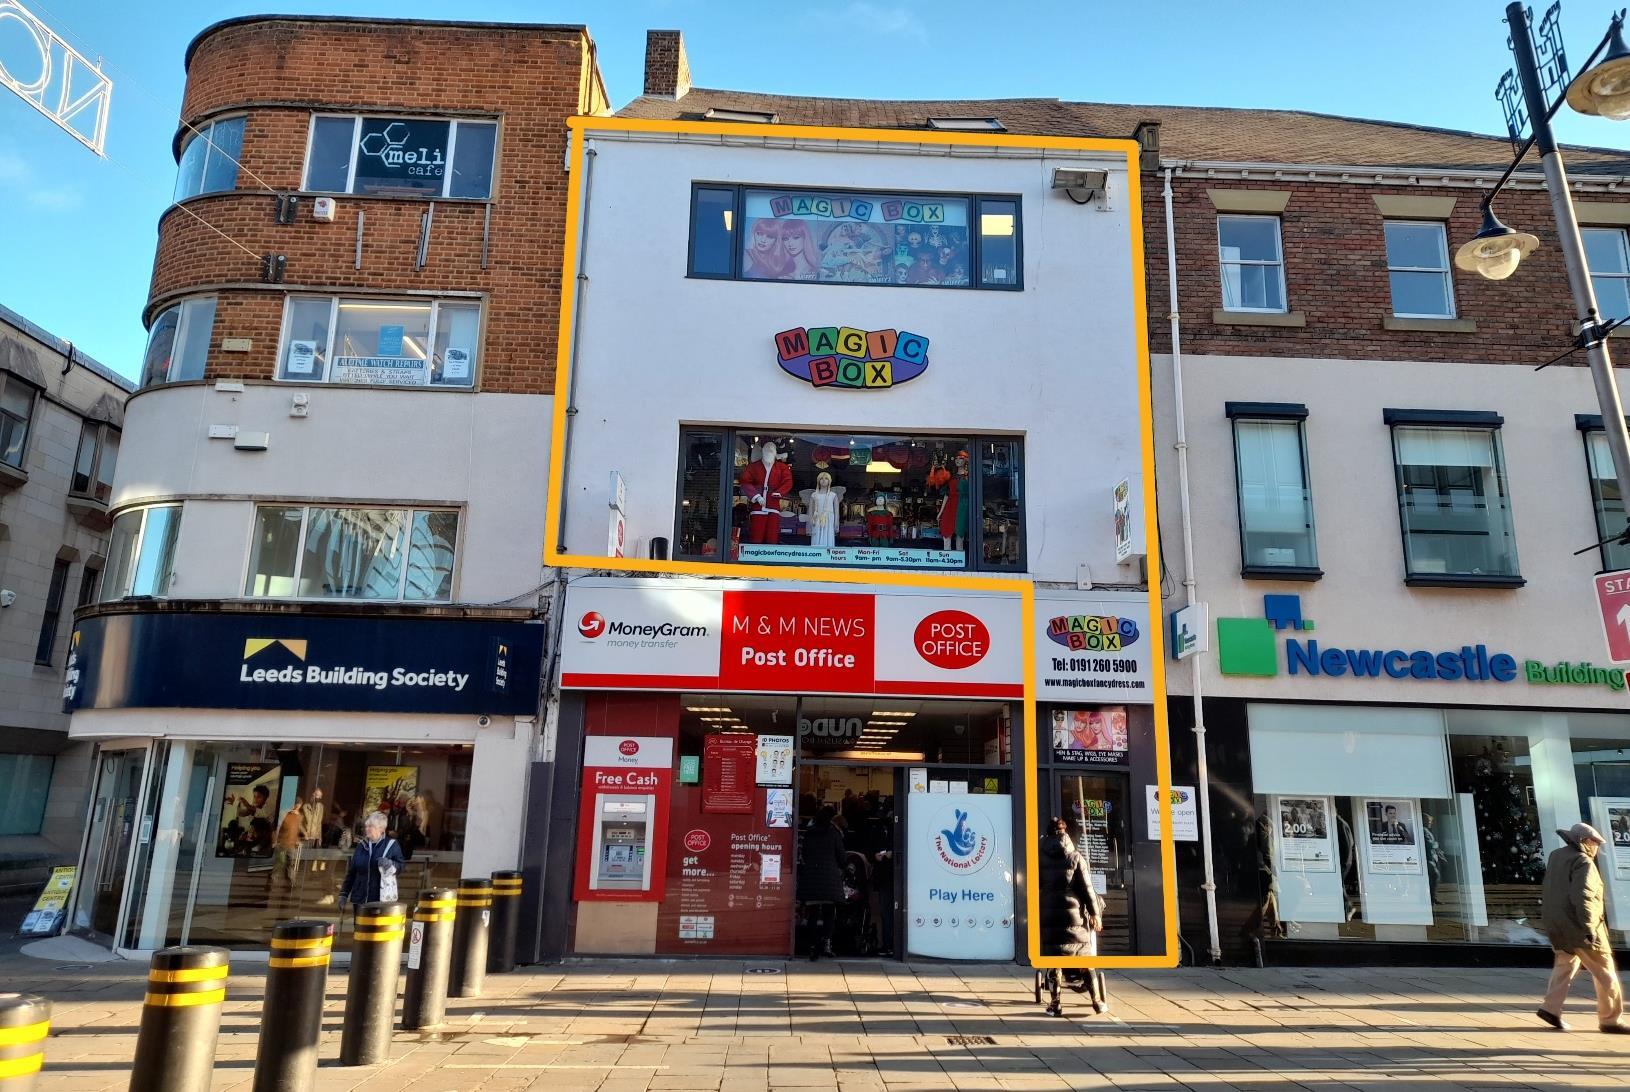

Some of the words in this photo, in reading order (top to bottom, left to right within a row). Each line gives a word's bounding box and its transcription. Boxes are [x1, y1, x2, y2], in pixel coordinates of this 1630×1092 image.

[387, 148, 444, 165] meli
[408, 165, 443, 176] cafe
[774, 198, 868, 217] MAGIC
[887, 204, 940, 219] BOX
[782, 332, 922, 359] MAGIC
[395, 359, 422, 369] REPAIRS
[814, 361, 888, 384] BOX
[744, 549, 822, 559] magicboxfancydress.com
[608, 621, 707, 641] MoneyGram
[733, 616, 750, 634] M
[757, 617, 771, 634] &
[779, 617, 796, 635] M
[804, 618, 865, 638] NEWS
[930, 623, 975, 639] POST
[1051, 617, 1134, 635] MAGIC
[607, 640, 637, 650] money
[639, 639, 679, 650] transfer
[922, 640, 982, 657] OFFICE
[1069, 634, 1118, 650] BOX
[741, 647, 787, 666] Post
[794, 648, 855, 668] Office
[1051, 658, 1069, 672] Tel:
[1069, 658, 1091, 672] 0191
[1092, 659, 1111, 673] 260
[1112, 659, 1138, 673] 5900
[1286, 638, 1518, 683] Newcastle
[1525, 660, 1625, 692] Building
[240, 663, 303, 684] Leeds
[306, 666, 388, 690] Building
[390, 668, 470, 692] Society
[1044, 678, 1145, 689] www.magicboxfancydress.com
[618, 756, 639, 765] Money
[595, 771, 623, 785] Free
[626, 771, 658, 786] Cash
[731, 833, 746, 841] Post
[748, 833, 768, 842] Office
[731, 842, 760, 852] opening
[761, 843, 782, 851] hours
[935, 835, 943, 851] The
[940, 851, 971, 868] National
[971, 836, 987, 865] Lottery
[682, 856, 699, 867] get
[682, 868, 715, 877] more...
[929, 888, 957, 904] Play
[962, 889, 994, 902] Here
